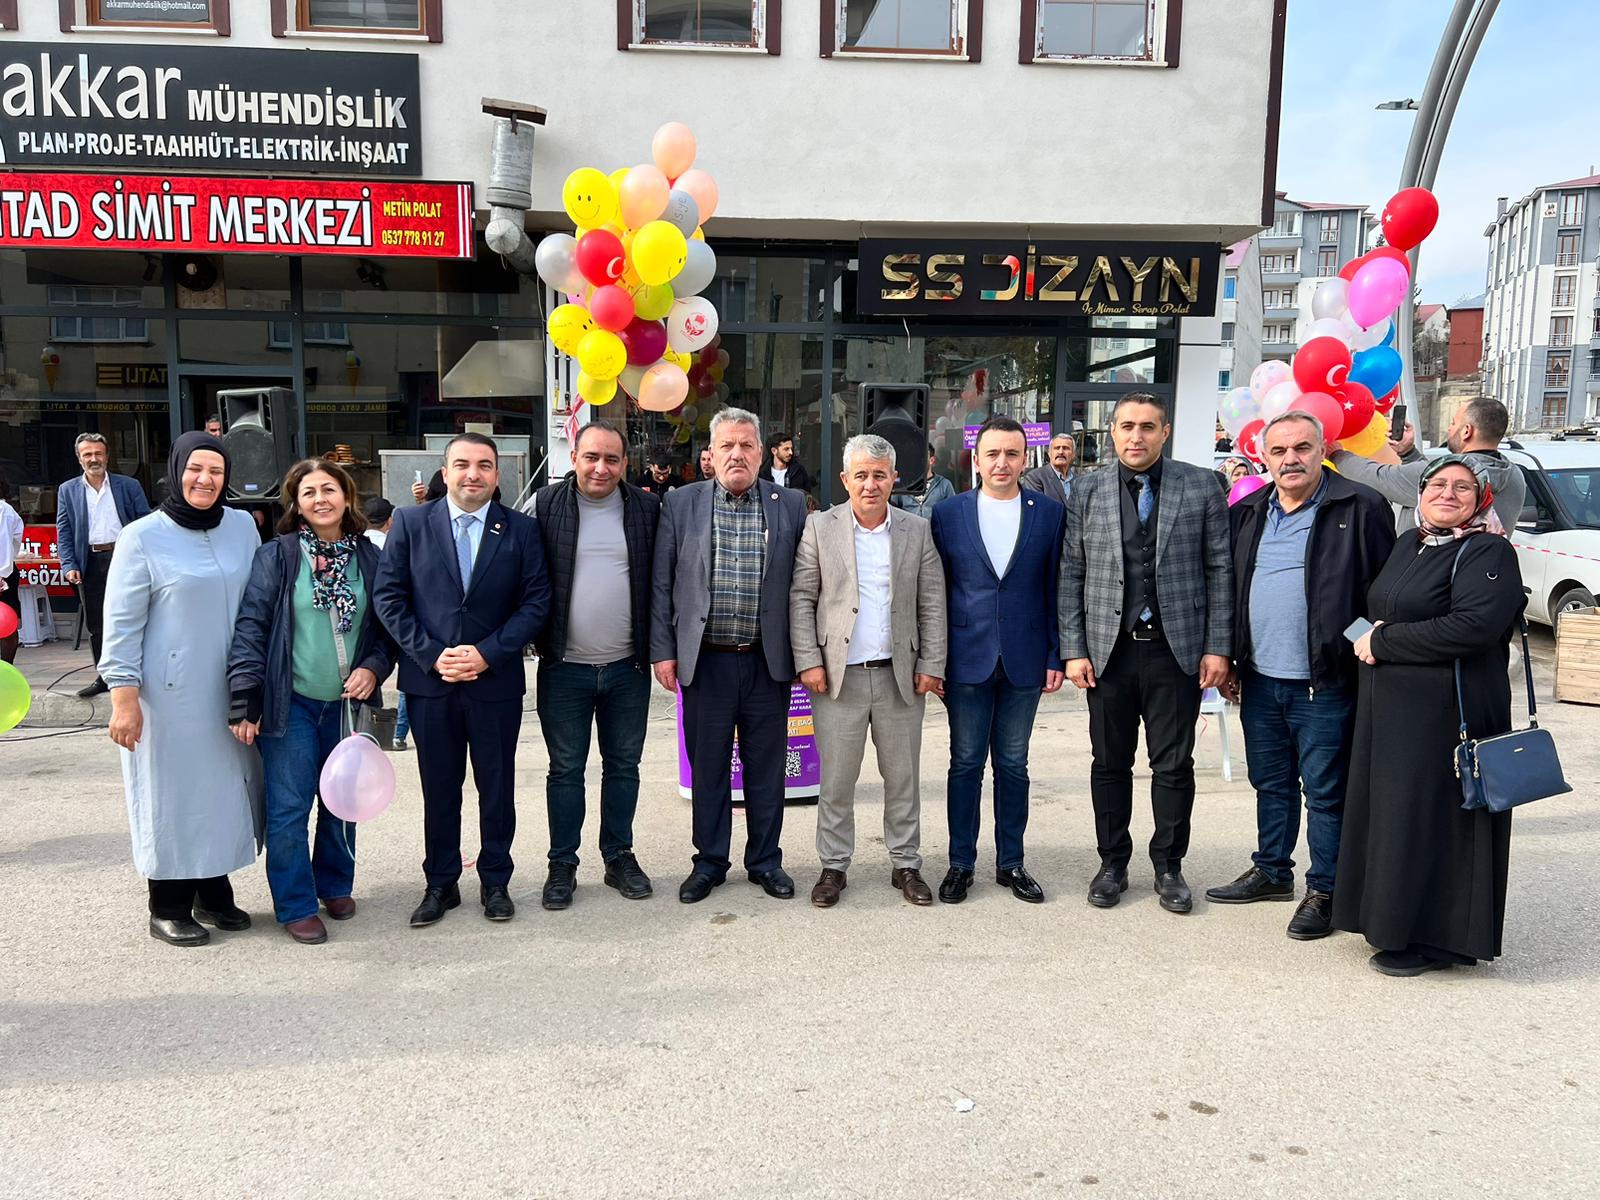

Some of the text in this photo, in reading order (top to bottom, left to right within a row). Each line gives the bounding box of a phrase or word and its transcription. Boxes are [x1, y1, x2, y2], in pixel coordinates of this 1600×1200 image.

[3, 53, 408, 129] akkar MÜHENDİSLİK
[0, 179, 373, 247] TAD SİMİT MERKEZİ
[383, 197, 442, 218] METİN POLAT
[382, 230, 445, 247] 0537 778 91 27
[881, 245, 1200, 302] SS DİZAYN
[1092, 302, 1126, 315] Mimar
[1132, 303, 1158, 315] Serap
[1160, 303, 1191, 314] Polat
